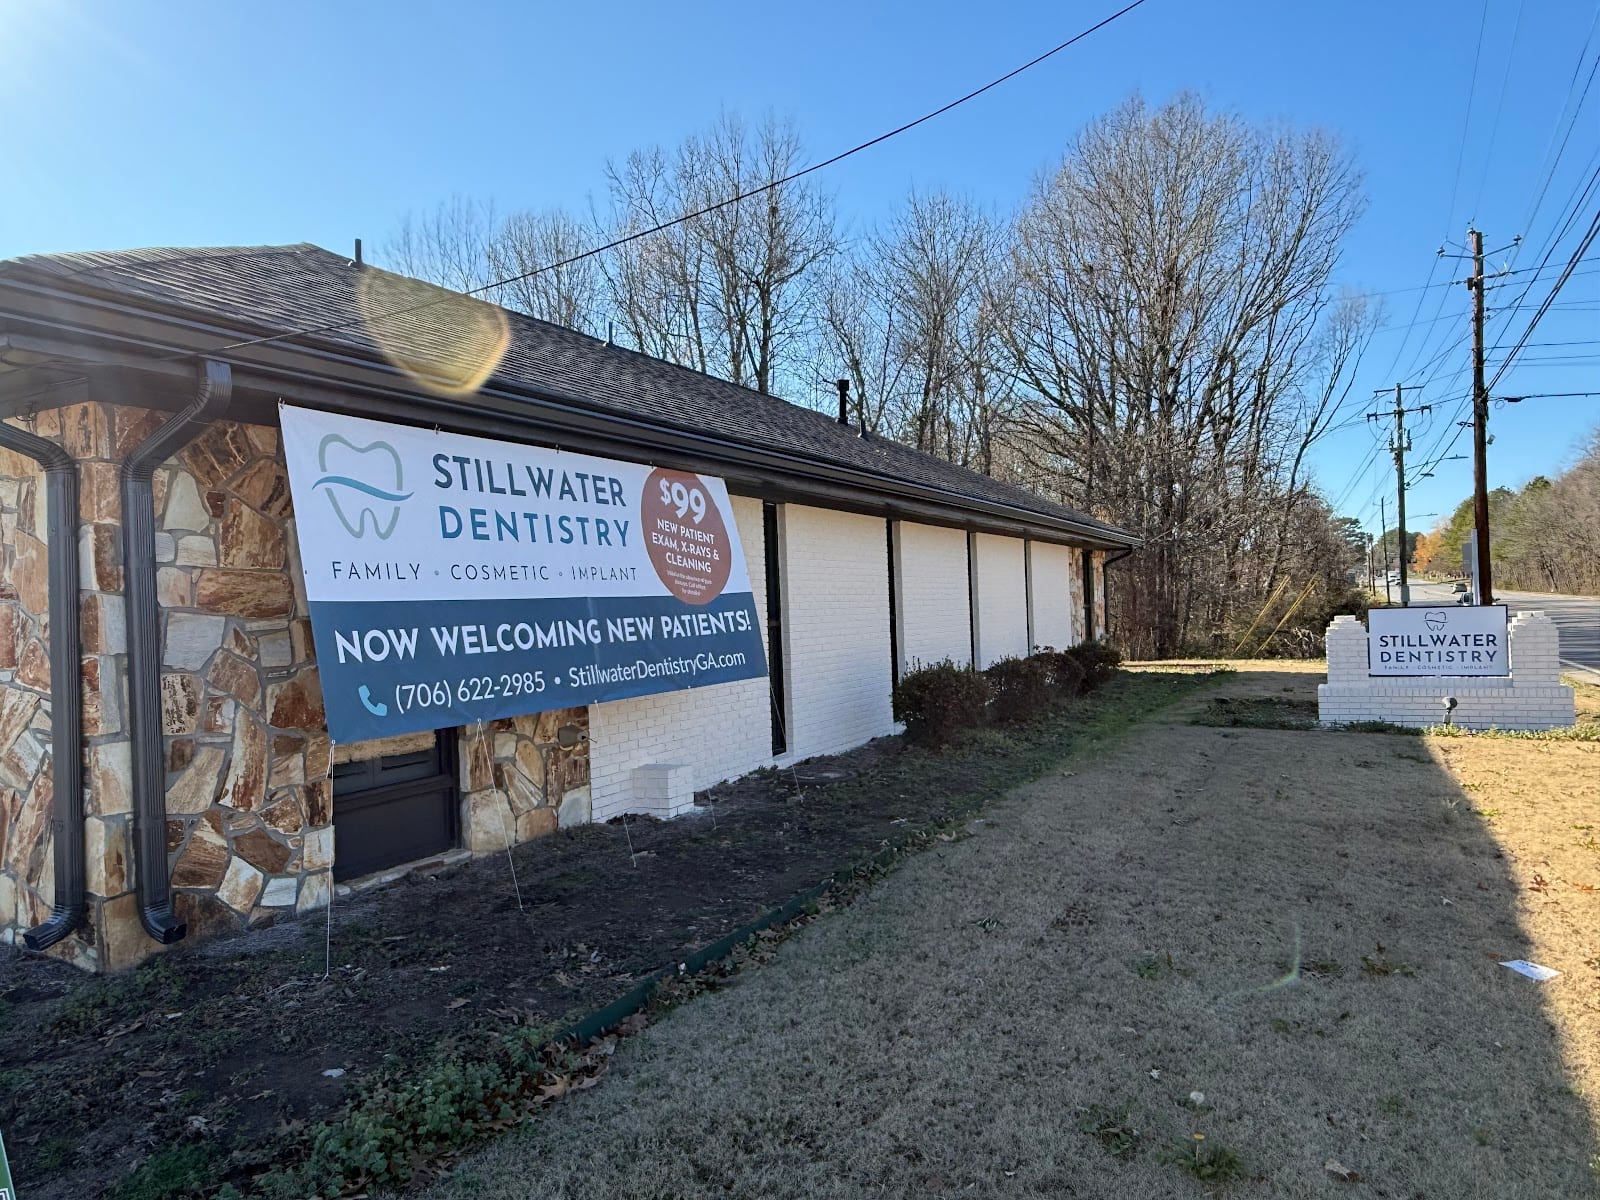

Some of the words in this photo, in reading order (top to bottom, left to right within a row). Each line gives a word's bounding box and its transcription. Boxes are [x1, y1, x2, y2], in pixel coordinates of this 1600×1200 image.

[432, 453, 627, 507] STILLWATER
[659, 477, 706, 525] $99
[438, 505, 630, 547] DENTISTRY
[656, 518, 678, 534] NEW
[680, 525, 715, 545] PATIENT
[652, 532, 680, 552] EXAM,
[681, 540, 711, 559] X-RAYS
[712, 549, 720, 561] &
[331, 561, 421, 581] FAMILY
[450, 564, 550, 581] COSMETIC
[571, 566, 638, 581] IMPLANT
[665, 552, 712, 573] CLEANING
[334, 628, 419, 664] NOW
[430, 618, 601, 657] WELCOMING
[606, 616, 655, 643] NEW
[660, 609, 752, 639] PATIENTS!
[1379, 633, 1498, 648] STILLWATER
[1380, 650, 1498, 663] DENTISTRY
[395, 679, 452, 714] (706)
[457, 670, 546, 702] 622-2985
[569, 651, 747, 687] StillwaterDentistryGA.com
